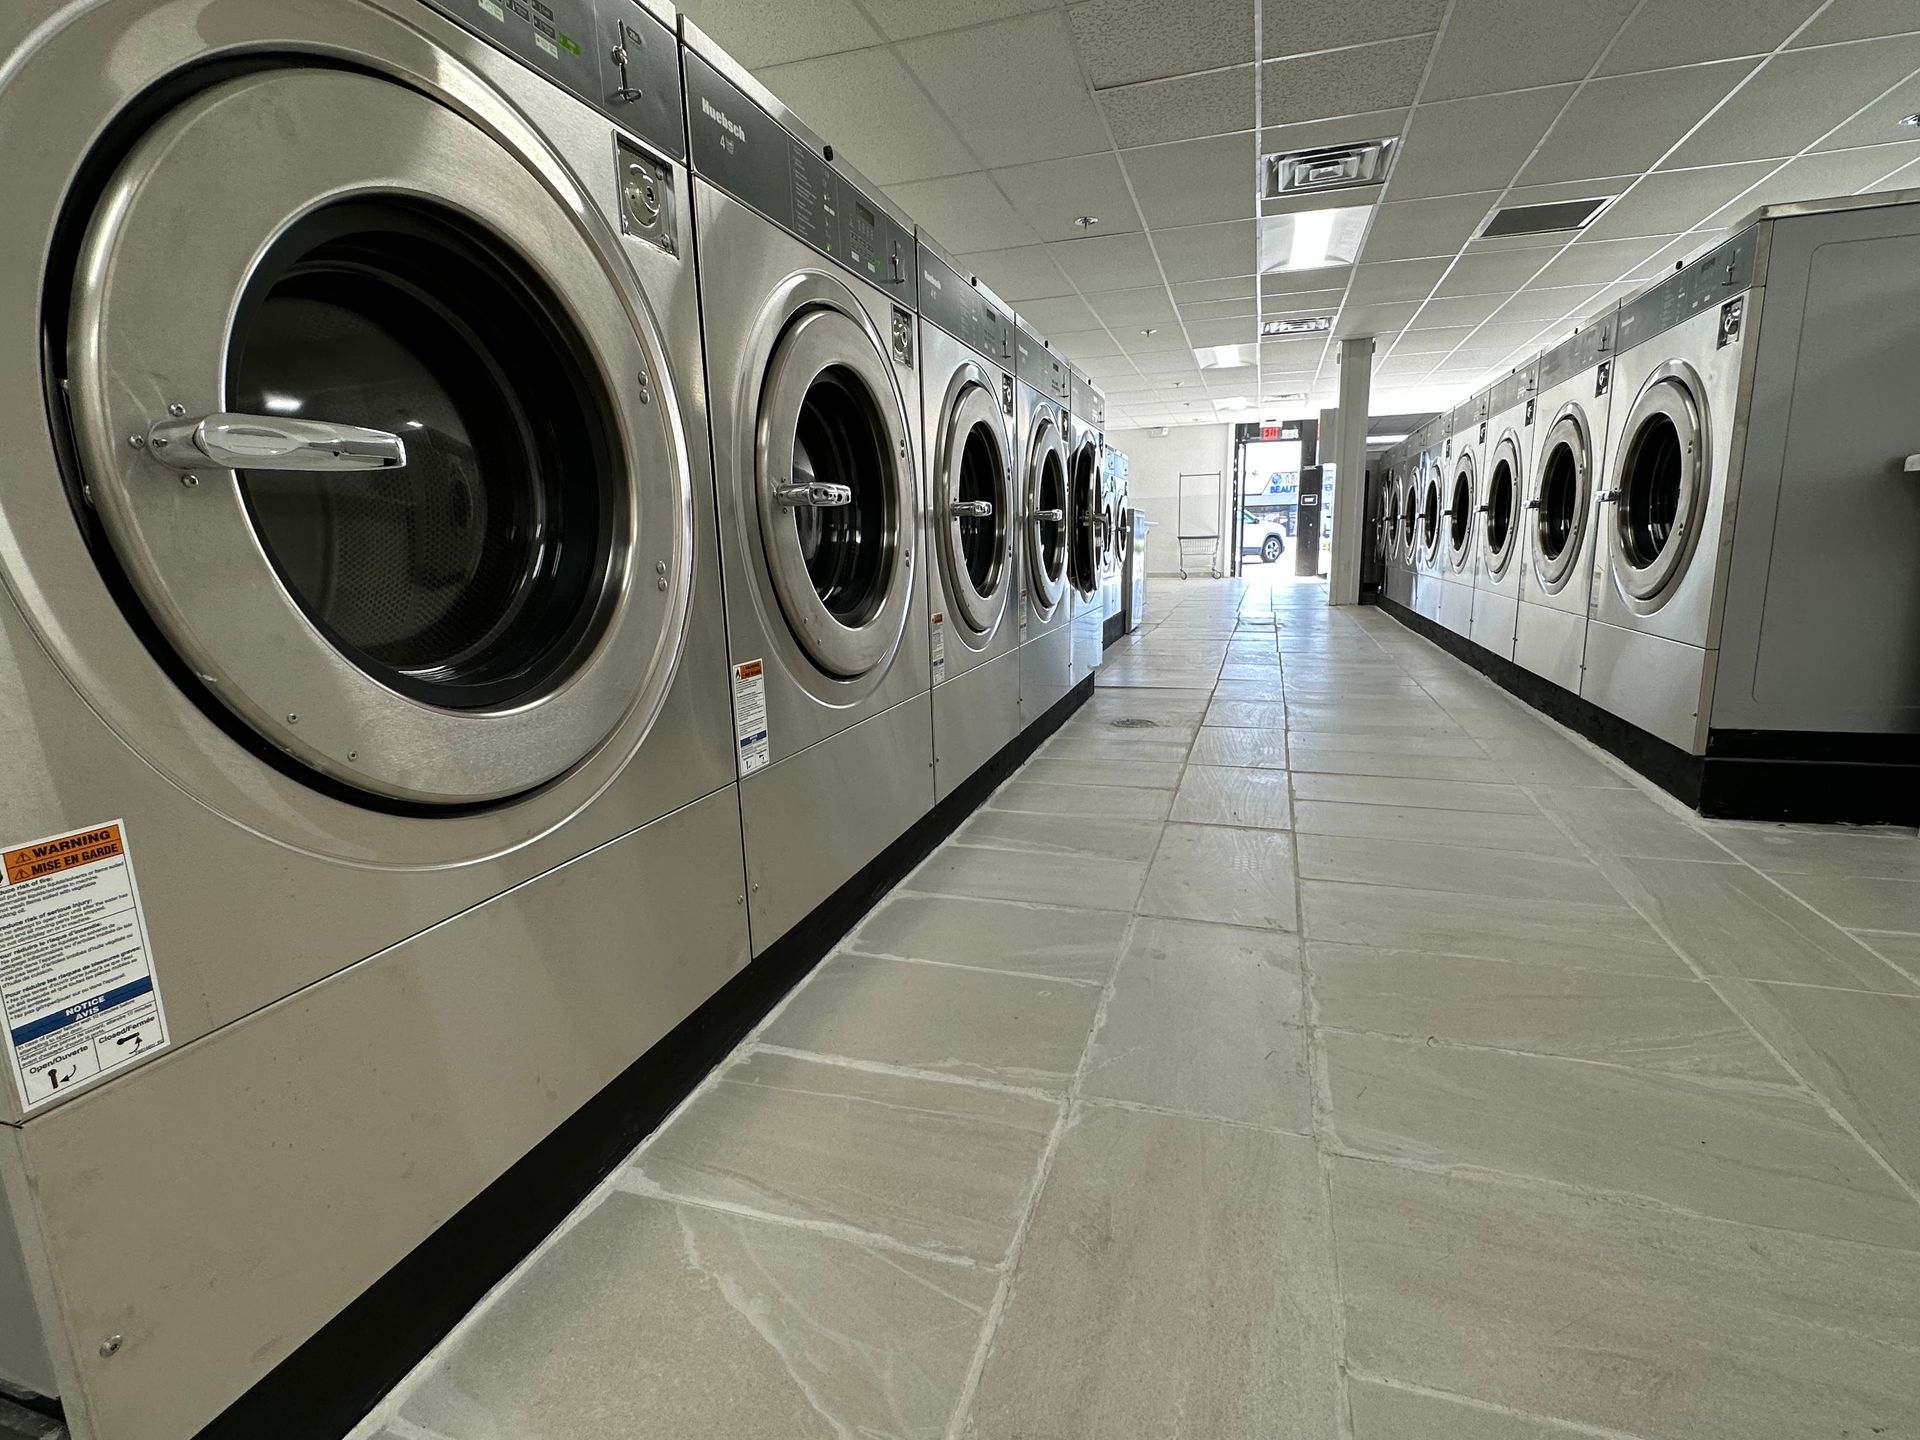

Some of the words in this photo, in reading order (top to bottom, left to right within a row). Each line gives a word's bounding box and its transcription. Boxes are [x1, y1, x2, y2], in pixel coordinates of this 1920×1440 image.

[702, 96, 746, 142] Huebsch
[31, 858, 61, 875] MISE
[64, 854, 79, 866] EN
[82, 843, 118, 861] GARDE
[32, 830, 110, 858] WARNING
[65, 995, 106, 1017] NOTICE
[75, 1006, 100, 1021] AVIS
[98, 1014, 155, 1044] Closed/Fermée
[29, 1044, 88, 1074] Open/Ouverte
